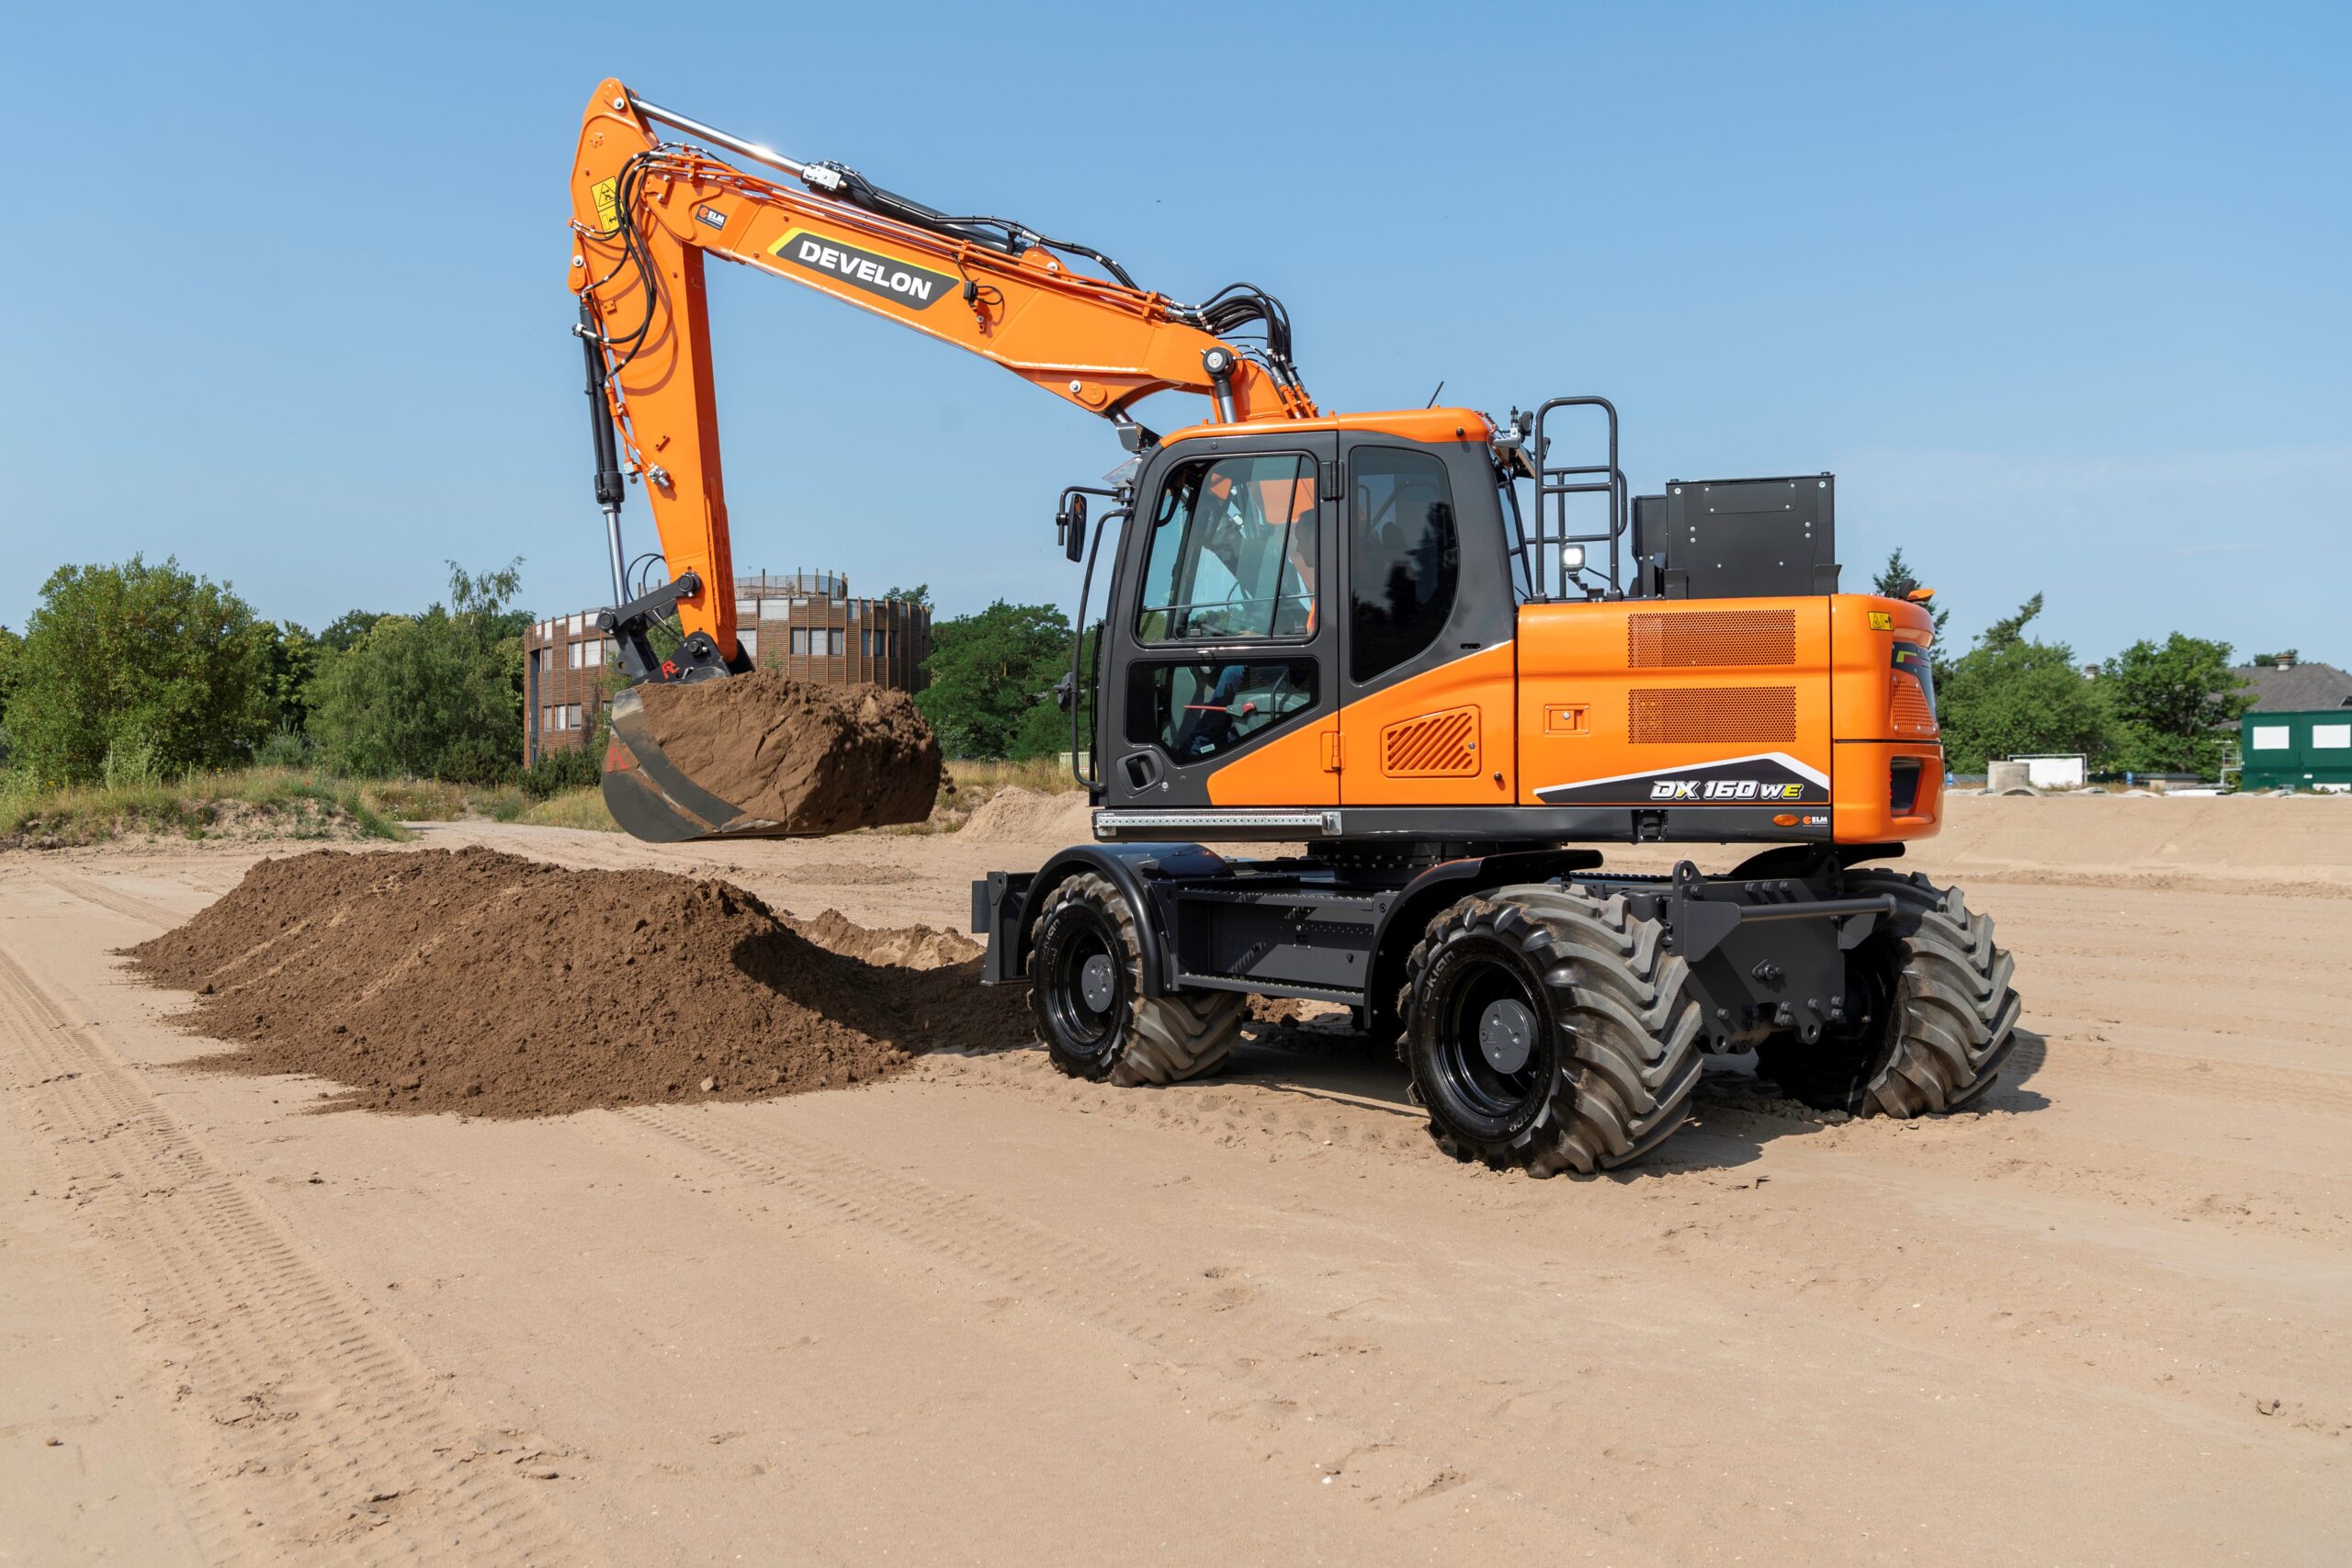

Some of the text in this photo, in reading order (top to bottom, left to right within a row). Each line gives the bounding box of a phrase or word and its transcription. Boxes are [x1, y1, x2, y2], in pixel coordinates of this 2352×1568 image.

[708, 210, 725, 224] ELM
[798, 240, 933, 300] DEVELON
[1651, 781, 1701, 799] DX
